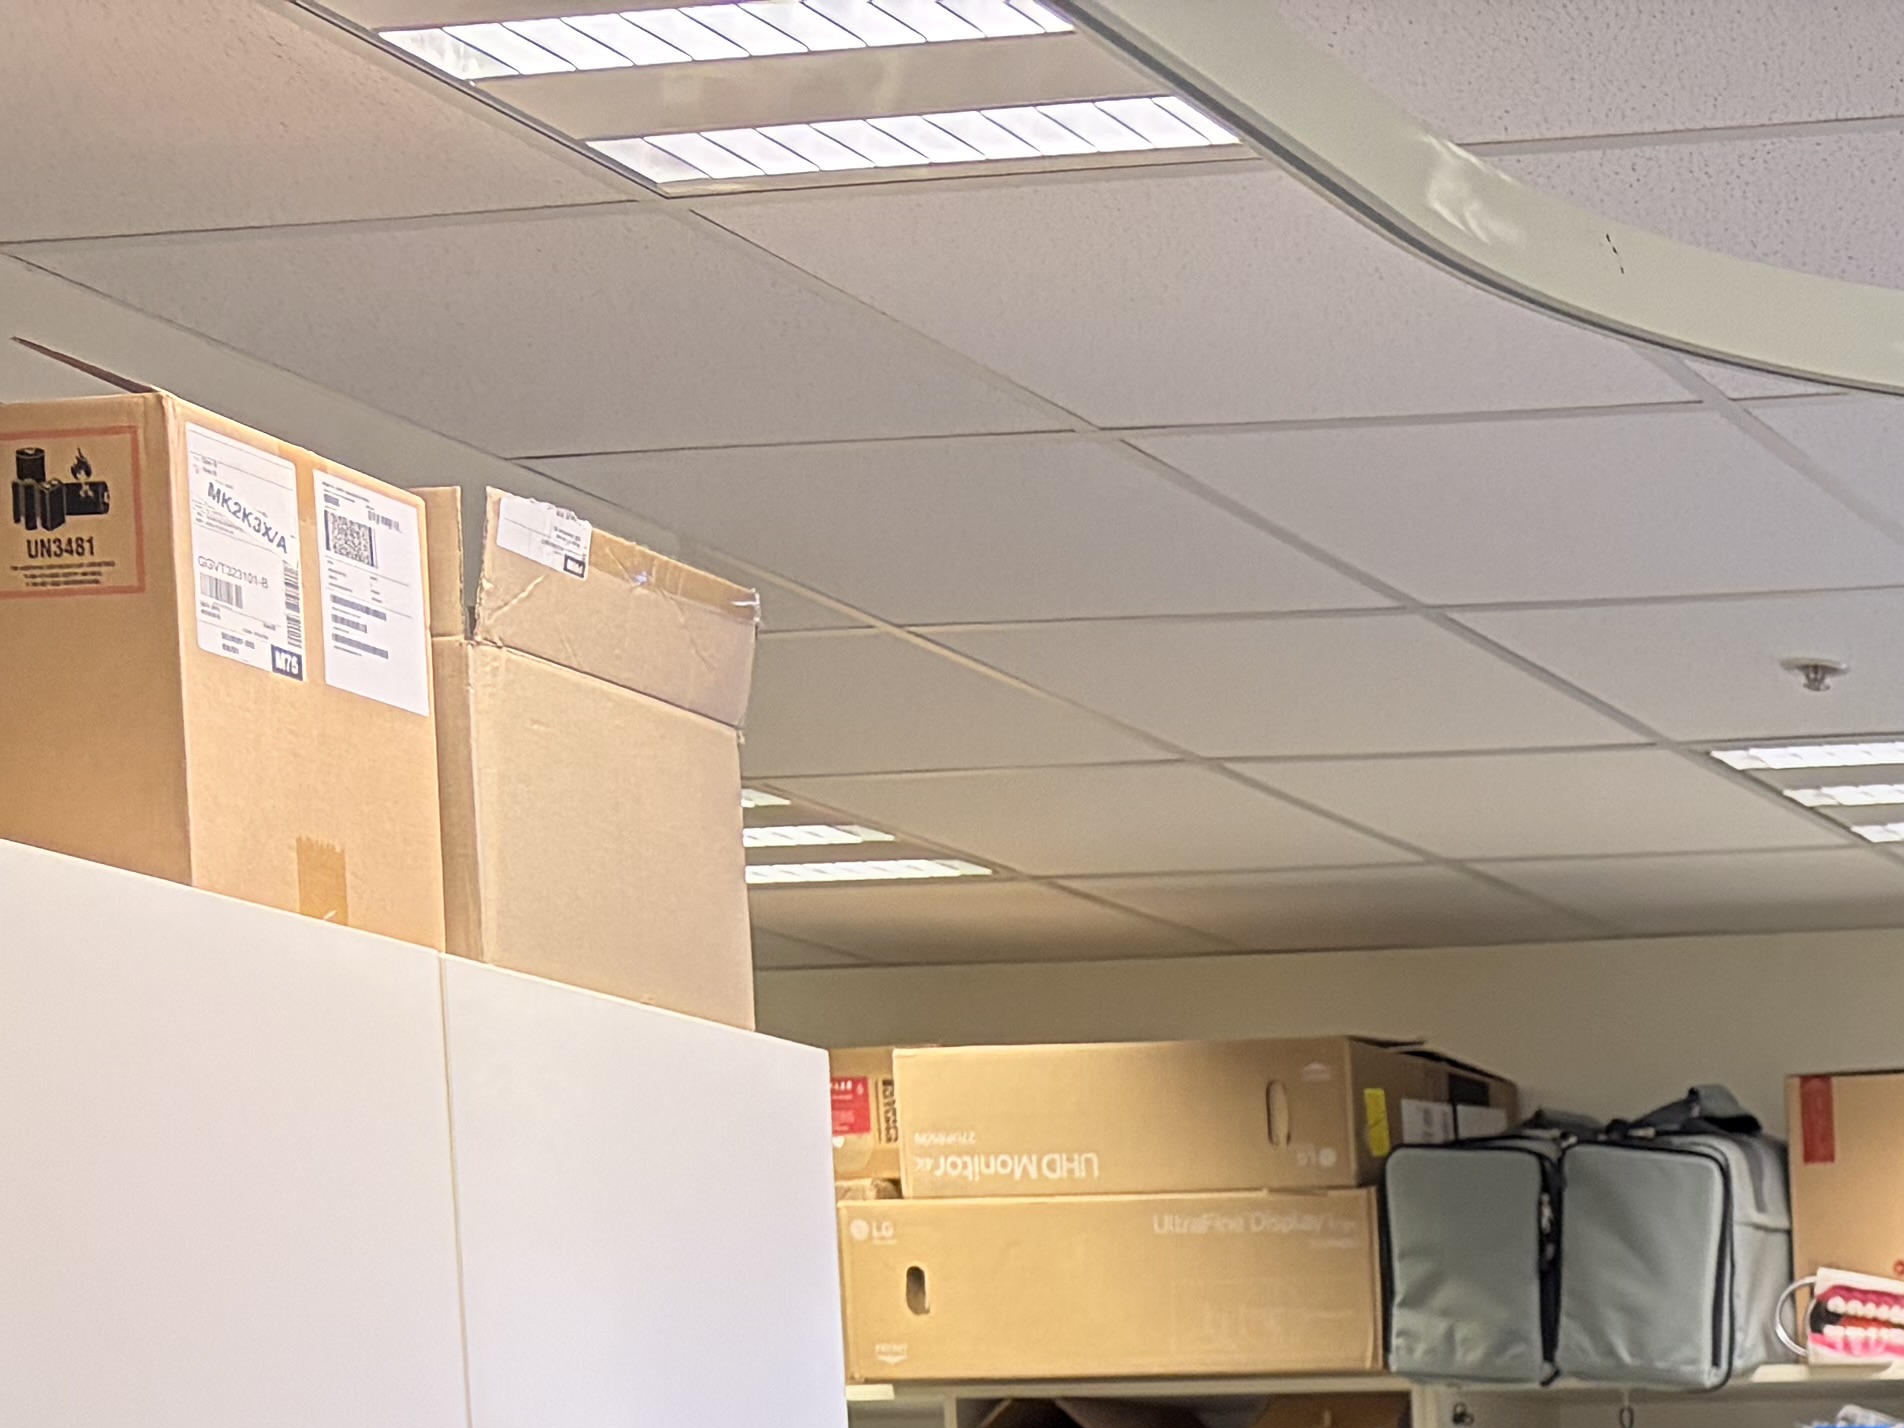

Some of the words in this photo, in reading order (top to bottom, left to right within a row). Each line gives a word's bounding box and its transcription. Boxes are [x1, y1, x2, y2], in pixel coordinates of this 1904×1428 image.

[26, 536, 96, 560] UN3481
[936, 1153, 1038, 1180] Monitor
[1042, 1152, 1099, 1180] UHD
[872, 1220, 894, 1238] LG
